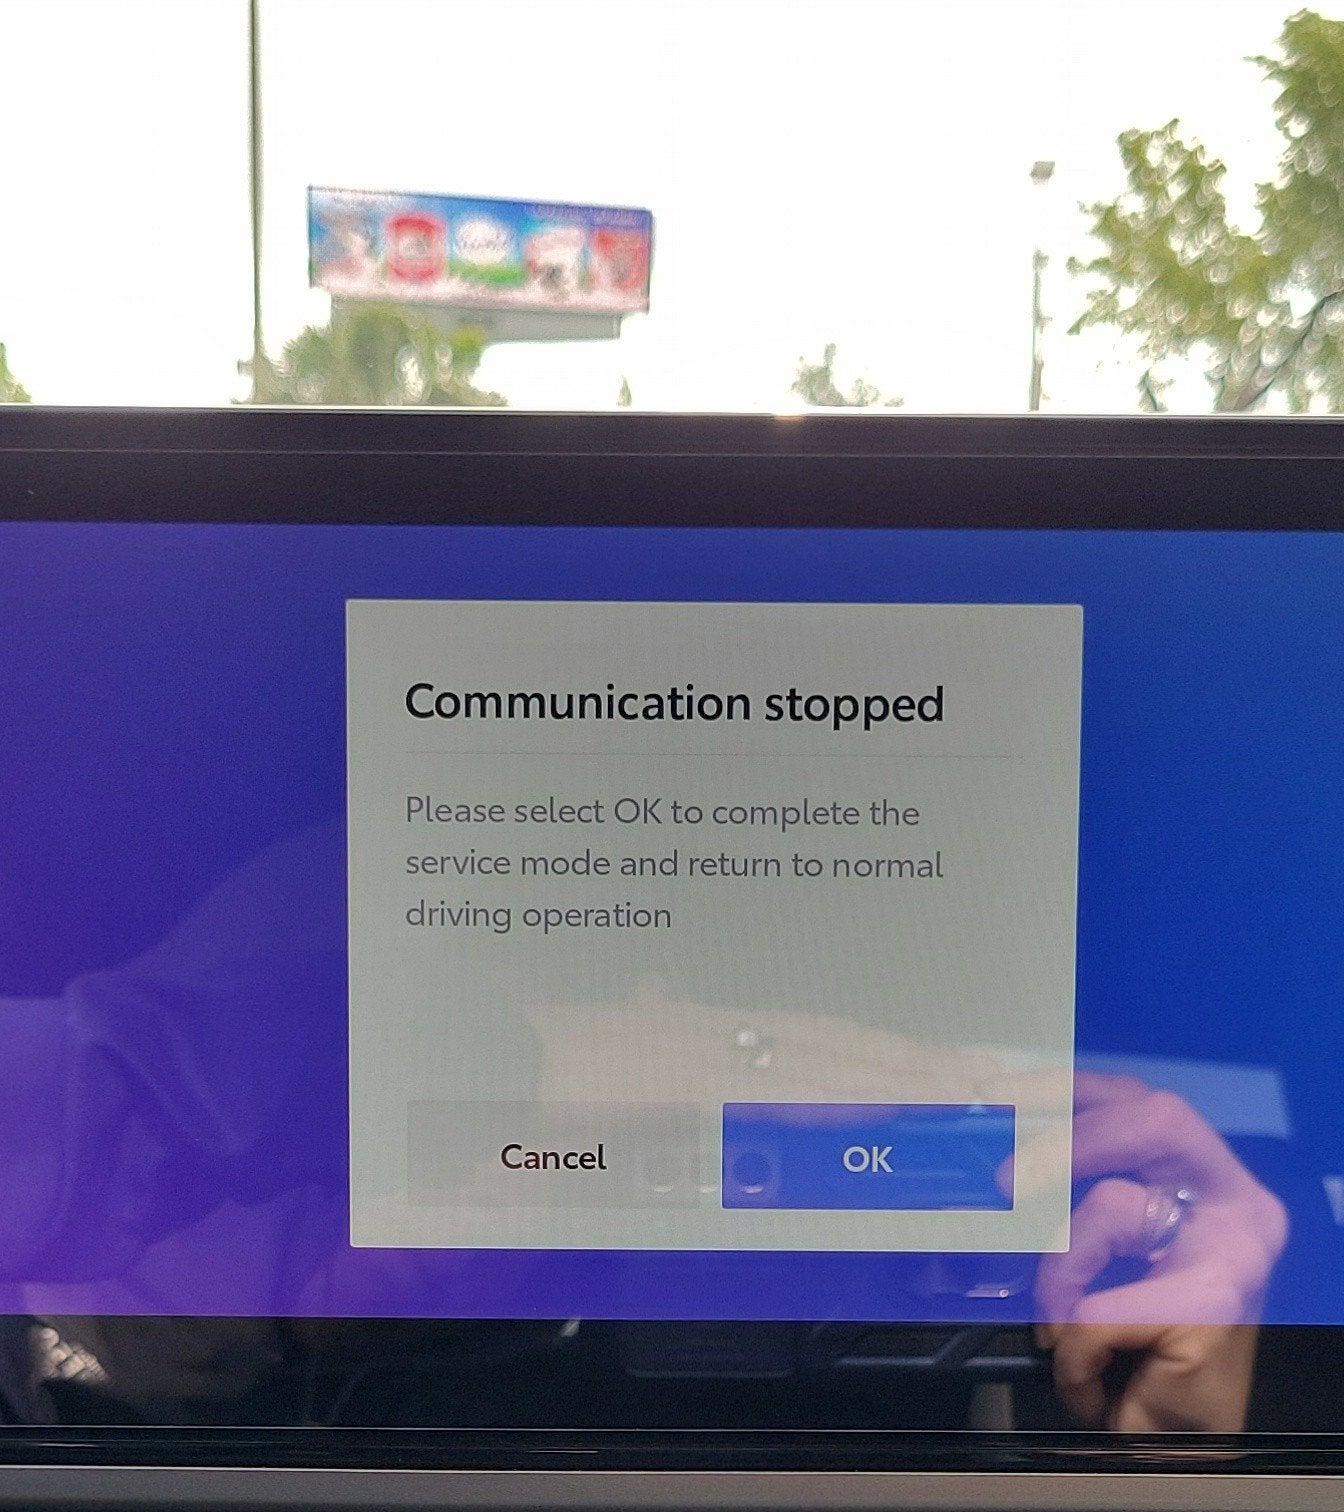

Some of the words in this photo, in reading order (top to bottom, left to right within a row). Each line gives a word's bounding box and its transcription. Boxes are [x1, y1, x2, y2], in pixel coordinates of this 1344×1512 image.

[405, 683, 751, 721] Communication
[765, 685, 945, 731] stopped
[406, 796, 506, 824] Please
[514, 796, 605, 824] select
[614, 798, 662, 825] OK
[670, 801, 704, 825] to
[712, 798, 861, 833] complete
[869, 799, 921, 826] the
[406, 848, 512, 876] service
[521, 849, 611, 876] mode
[620, 849, 678, 877] and
[689, 852, 781, 877] return
[792, 854, 824, 877] to
[832, 850, 945, 879] normal
[405, 899, 512, 935] driving
[522, 901, 672, 935] operation
[501, 1143, 607, 1170] Cancel
[843, 1146, 893, 1173] OK
